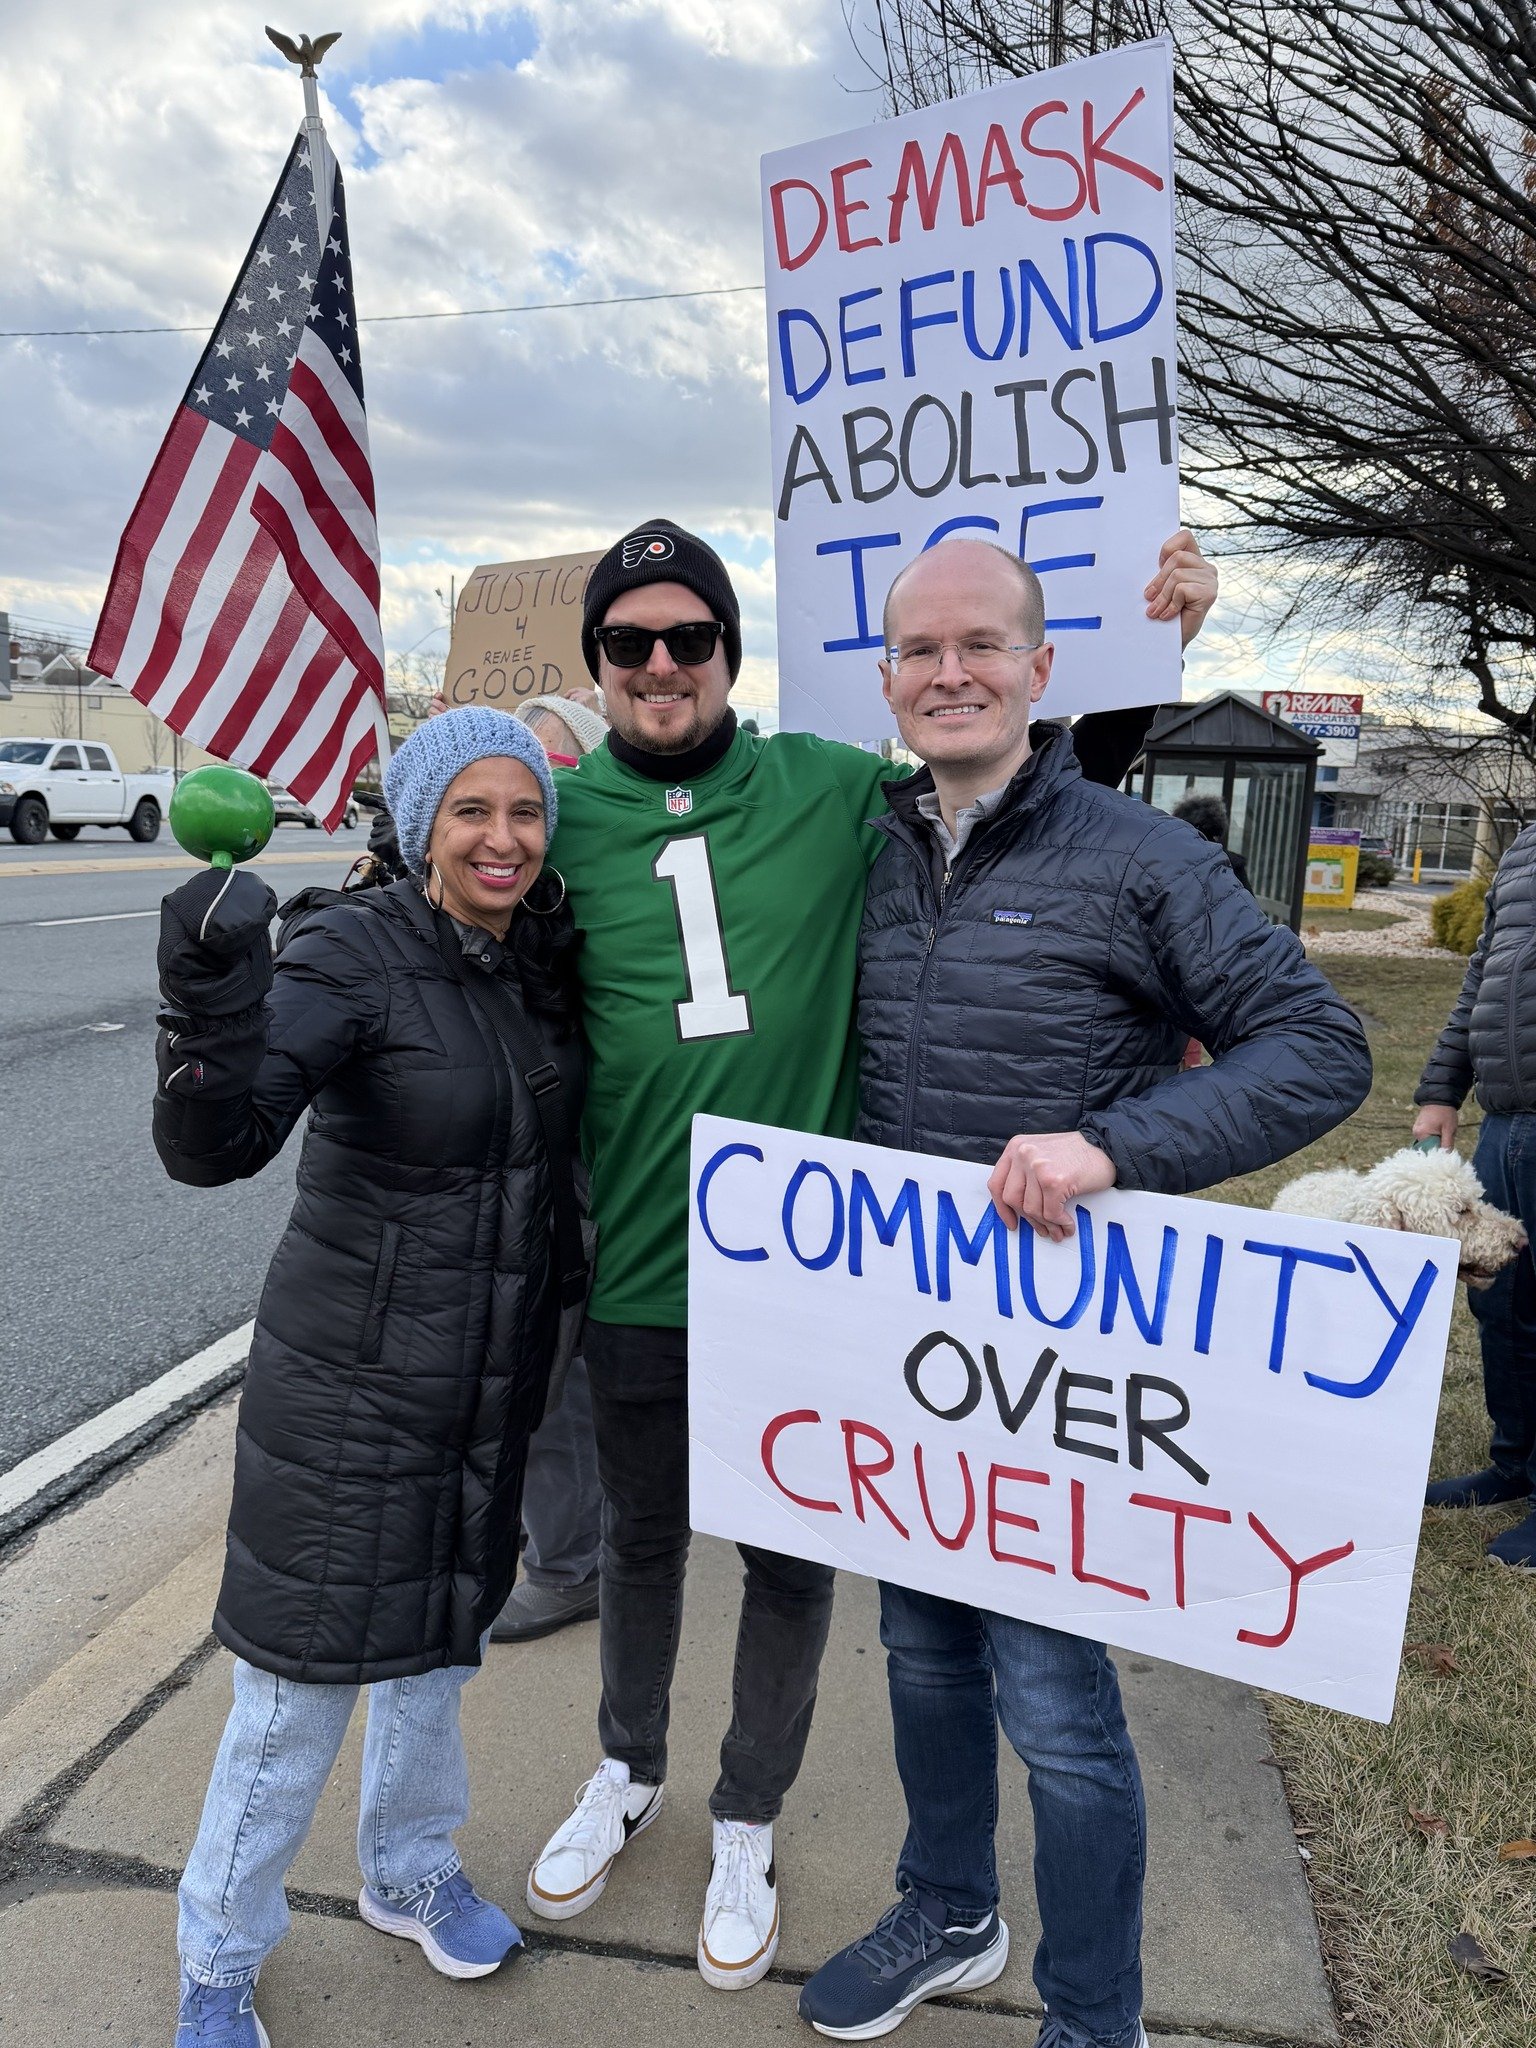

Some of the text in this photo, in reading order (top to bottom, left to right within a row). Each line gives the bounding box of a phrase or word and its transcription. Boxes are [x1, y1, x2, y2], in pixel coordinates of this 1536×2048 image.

[771, 87, 1164, 271] DEMASK
[777, 231, 1164, 406] DEFUND
[777, 355, 1176, 521] ABOLISH
[515, 615, 528, 639] 4
[816, 495, 1104, 654] IE
[452, 663, 563, 704] GOOD
[482, 645, 536, 665] RENEE
[1292, 713, 1357, 724] ASSOCIATES
[669, 798, 689, 811] NFL
[651, 831, 755, 1044] 1
[696, 1142, 1440, 1400] COMMUNITY
[903, 1330, 1211, 1487] OVER
[760, 1409, 1355, 1649] CRUELTY
